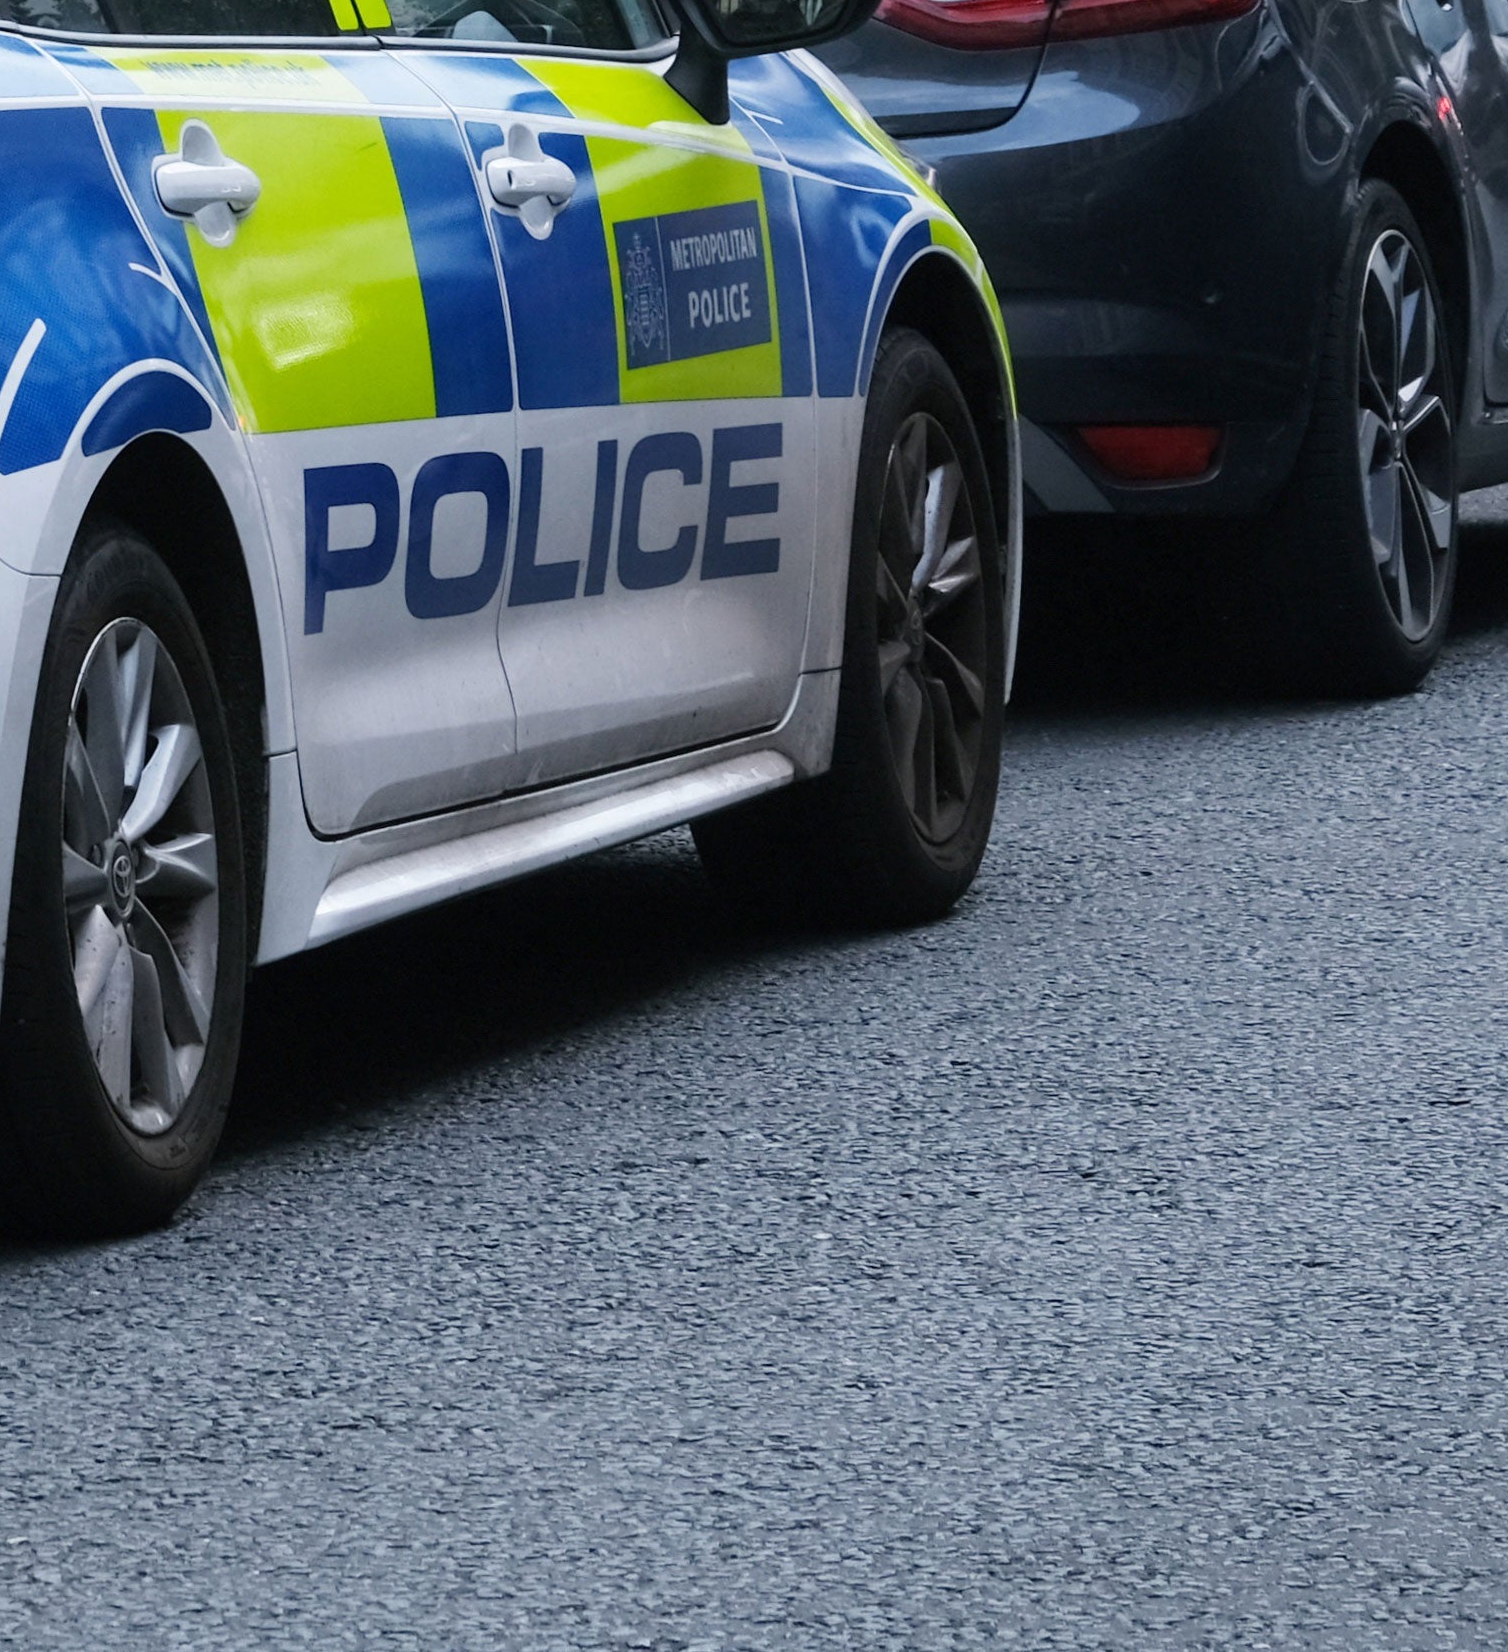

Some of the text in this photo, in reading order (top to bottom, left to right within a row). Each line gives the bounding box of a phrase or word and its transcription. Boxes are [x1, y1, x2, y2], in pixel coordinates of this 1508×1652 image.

[670, 227, 758, 272] METROPOLITAN
[688, 282, 752, 329] POLICE
[303, 422, 783, 635] POLICE
